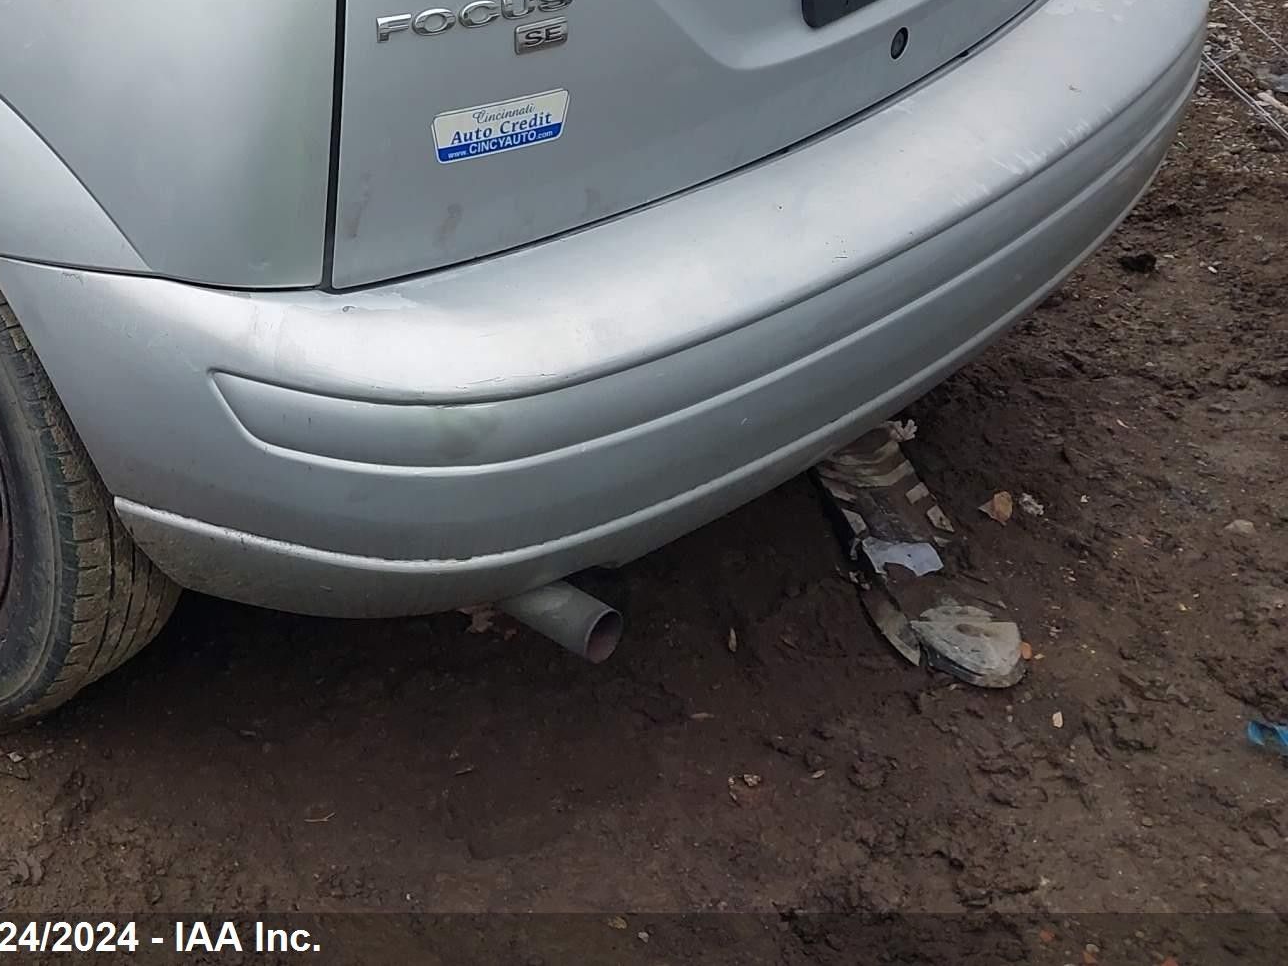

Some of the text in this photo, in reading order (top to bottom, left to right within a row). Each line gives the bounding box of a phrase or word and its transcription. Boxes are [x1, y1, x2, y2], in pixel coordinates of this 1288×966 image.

[524, 26, 564, 47] SE
[472, 103, 535, 124] Cincinnati
[450, 113, 552, 146] Auto Credit
